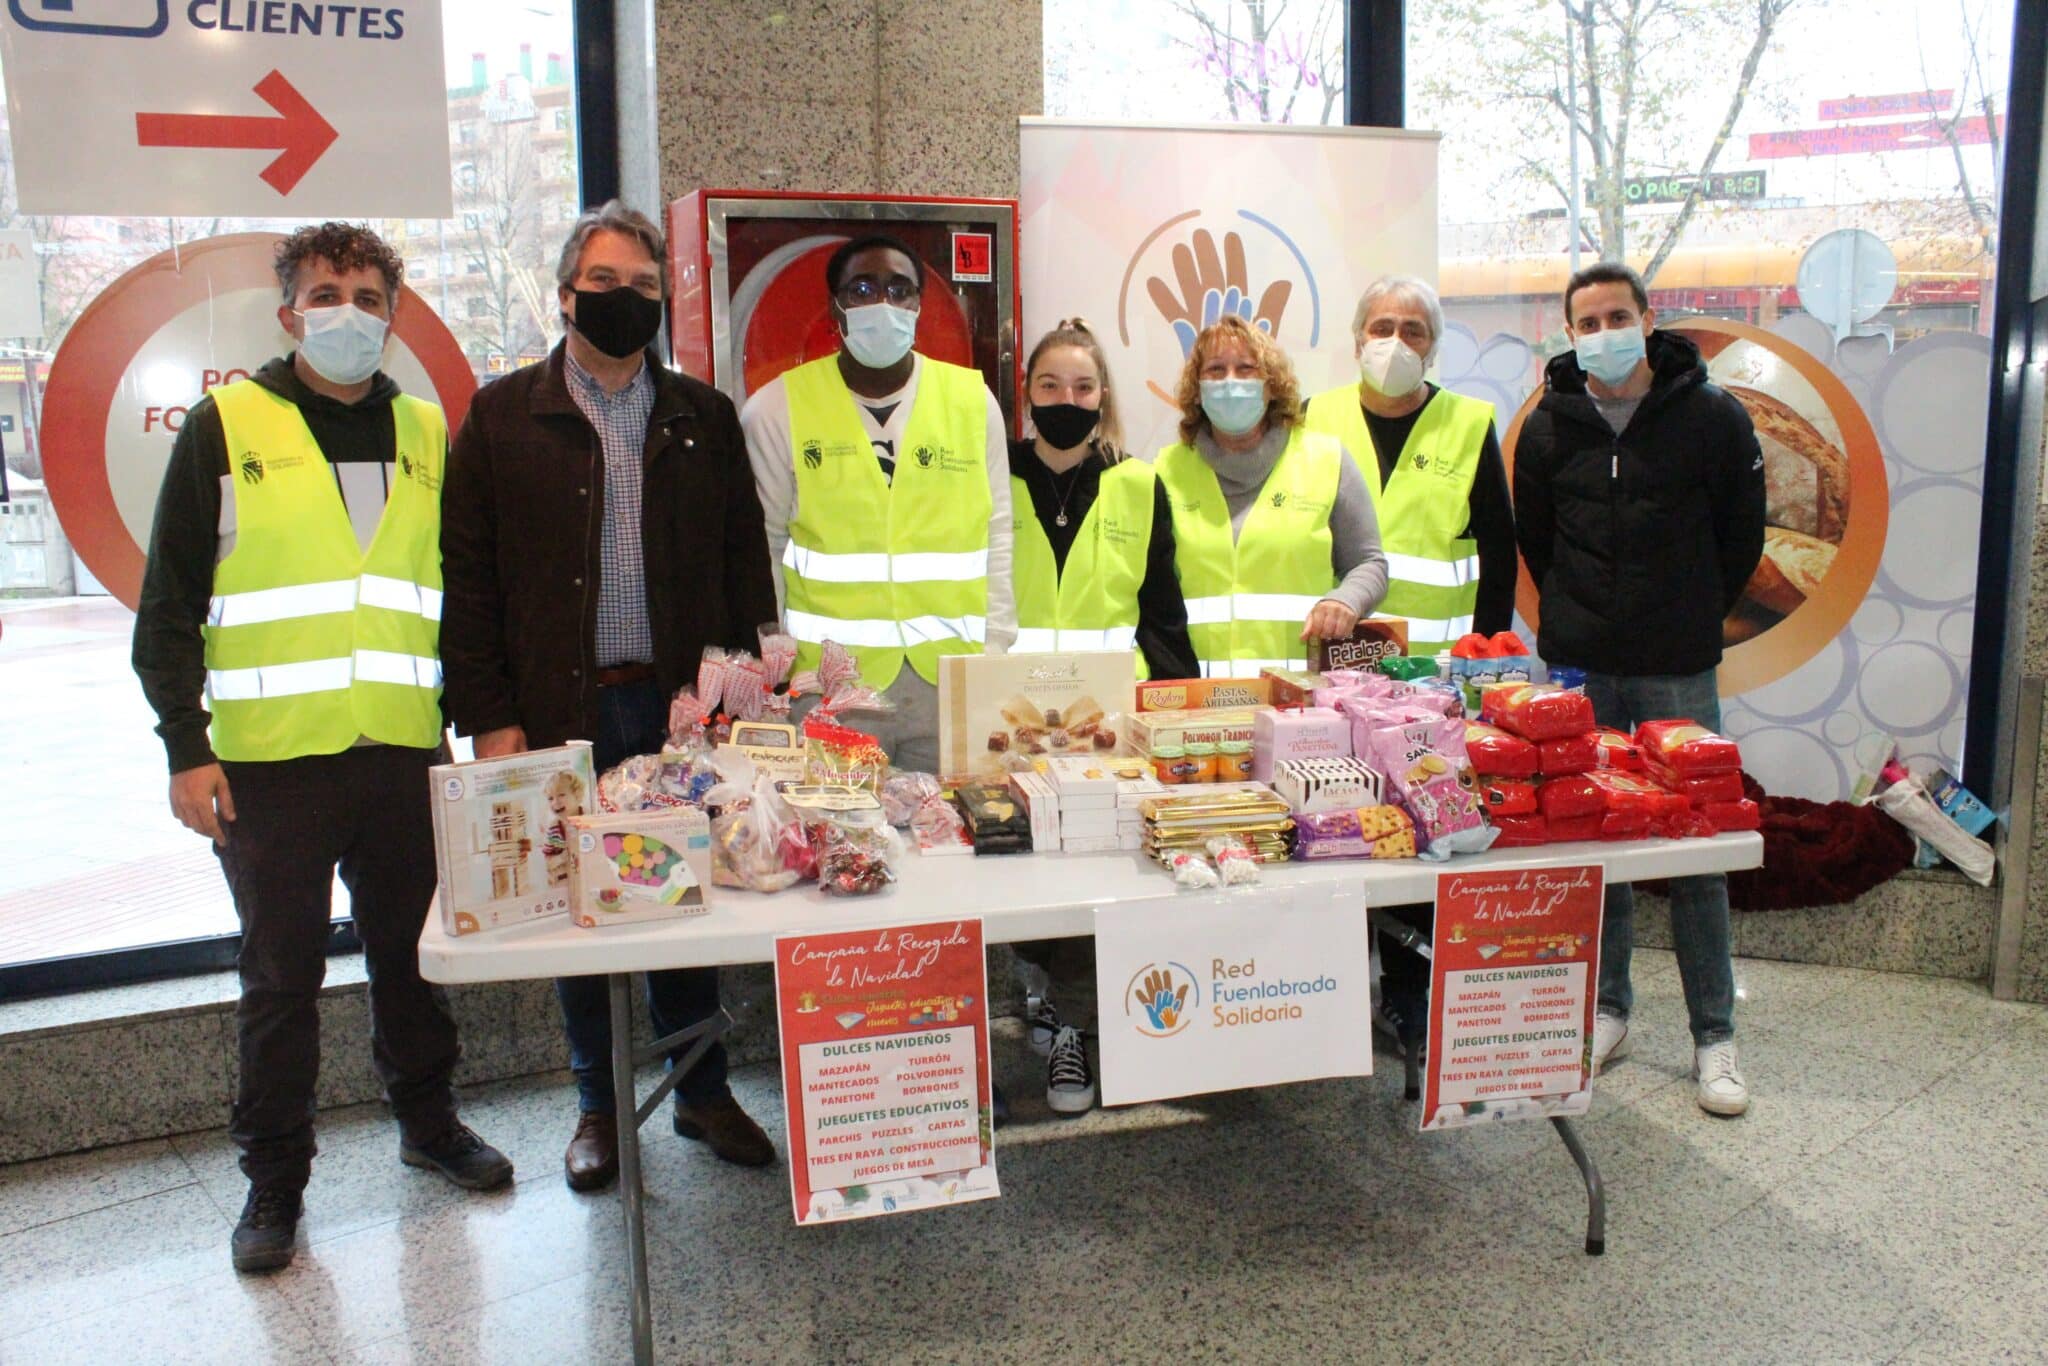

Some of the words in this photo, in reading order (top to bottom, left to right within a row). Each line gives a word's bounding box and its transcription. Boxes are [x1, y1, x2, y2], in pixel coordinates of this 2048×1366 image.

[187, 0, 404, 40] CLIENTES
[1329, 640, 1383, 665] Pétalos
[1212, 686, 1248, 698] PASTAS
[1202, 696, 1259, 708] ARTESANAS
[1449, 878, 1510, 901] Campaña
[1515, 872, 1530, 891] de
[1533, 869, 1592, 904] Recogida
[1474, 901, 1489, 920] de
[1493, 897, 1554, 922] Navidad
[791, 941, 867, 969] Campaña
[874, 933, 891, 953] de
[898, 923, 970, 966] Recogida
[826, 967, 844, 988] de
[850, 960, 923, 989] Navidad
[1212, 958, 1255, 980] Red
[1464, 972, 1504, 984] DULCES
[1506, 967, 1569, 981] NAVIDEÑOS
[1213, 975, 1336, 1003] Fuenlabrada
[1458, 989, 1501, 1001] MAZAPÁN
[1531, 985, 1566, 996] TURRÓN
[1448, 1003, 1507, 1015] MANTECADOS
[1520, 998, 1575, 1009] POLVORONES
[1213, 1003, 1302, 1027] Solidaria
[1457, 1017, 1501, 1028] PANETONE
[1523, 1012, 1570, 1023] BOMBONES
[823, 1042, 872, 1057] DULCES
[875, 1032, 952, 1051] NAVIDEÑOS
[1452, 1034, 1510, 1050] JUEGUETES
[1512, 1029, 1577, 1043] EDUCATIVOS
[908, 1052, 951, 1066] TURRÓN
[1451, 1054, 1488, 1065] PARCHIS
[1495, 1051, 1530, 1061] PUZZLES
[1541, 1047, 1573, 1057] CARTAS
[818, 1061, 871, 1077] MAZAPÁN
[896, 1066, 965, 1082] POLVORONES
[1442, 1072, 1463, 1082] TRES
[1465, 1070, 1477, 1080] EN
[1479, 1068, 1504, 1079] RAYA
[1507, 1063, 1581, 1077] CONSTRUCCIONES
[808, 1076, 880, 1093] MANTECADOS
[902, 1081, 960, 1096] BOMBONES
[1475, 1083, 1506, 1096] JUEGOS
[1507, 1082, 1519, 1091] DE
[1520, 1081, 1543, 1090] MESA
[821, 1091, 876, 1106] PANETONE
[817, 1109, 886, 1130] JUEGUETES
[890, 1099, 970, 1117] EDUCATIVOS
[818, 1133, 863, 1146] PARCHIS
[871, 1126, 914, 1140] PUZZLES
[928, 1119, 966, 1131] CARTAS
[810, 1154, 835, 1166] TRES
[838, 1152, 853, 1163] EN
[855, 1148, 885, 1161] RAYA
[890, 1135, 978, 1155] CONSTRUCCIONES
[853, 1163, 890, 1179] JUEGOS
[892, 1161, 905, 1172] DE
[907, 1157, 935, 1169] MESA
